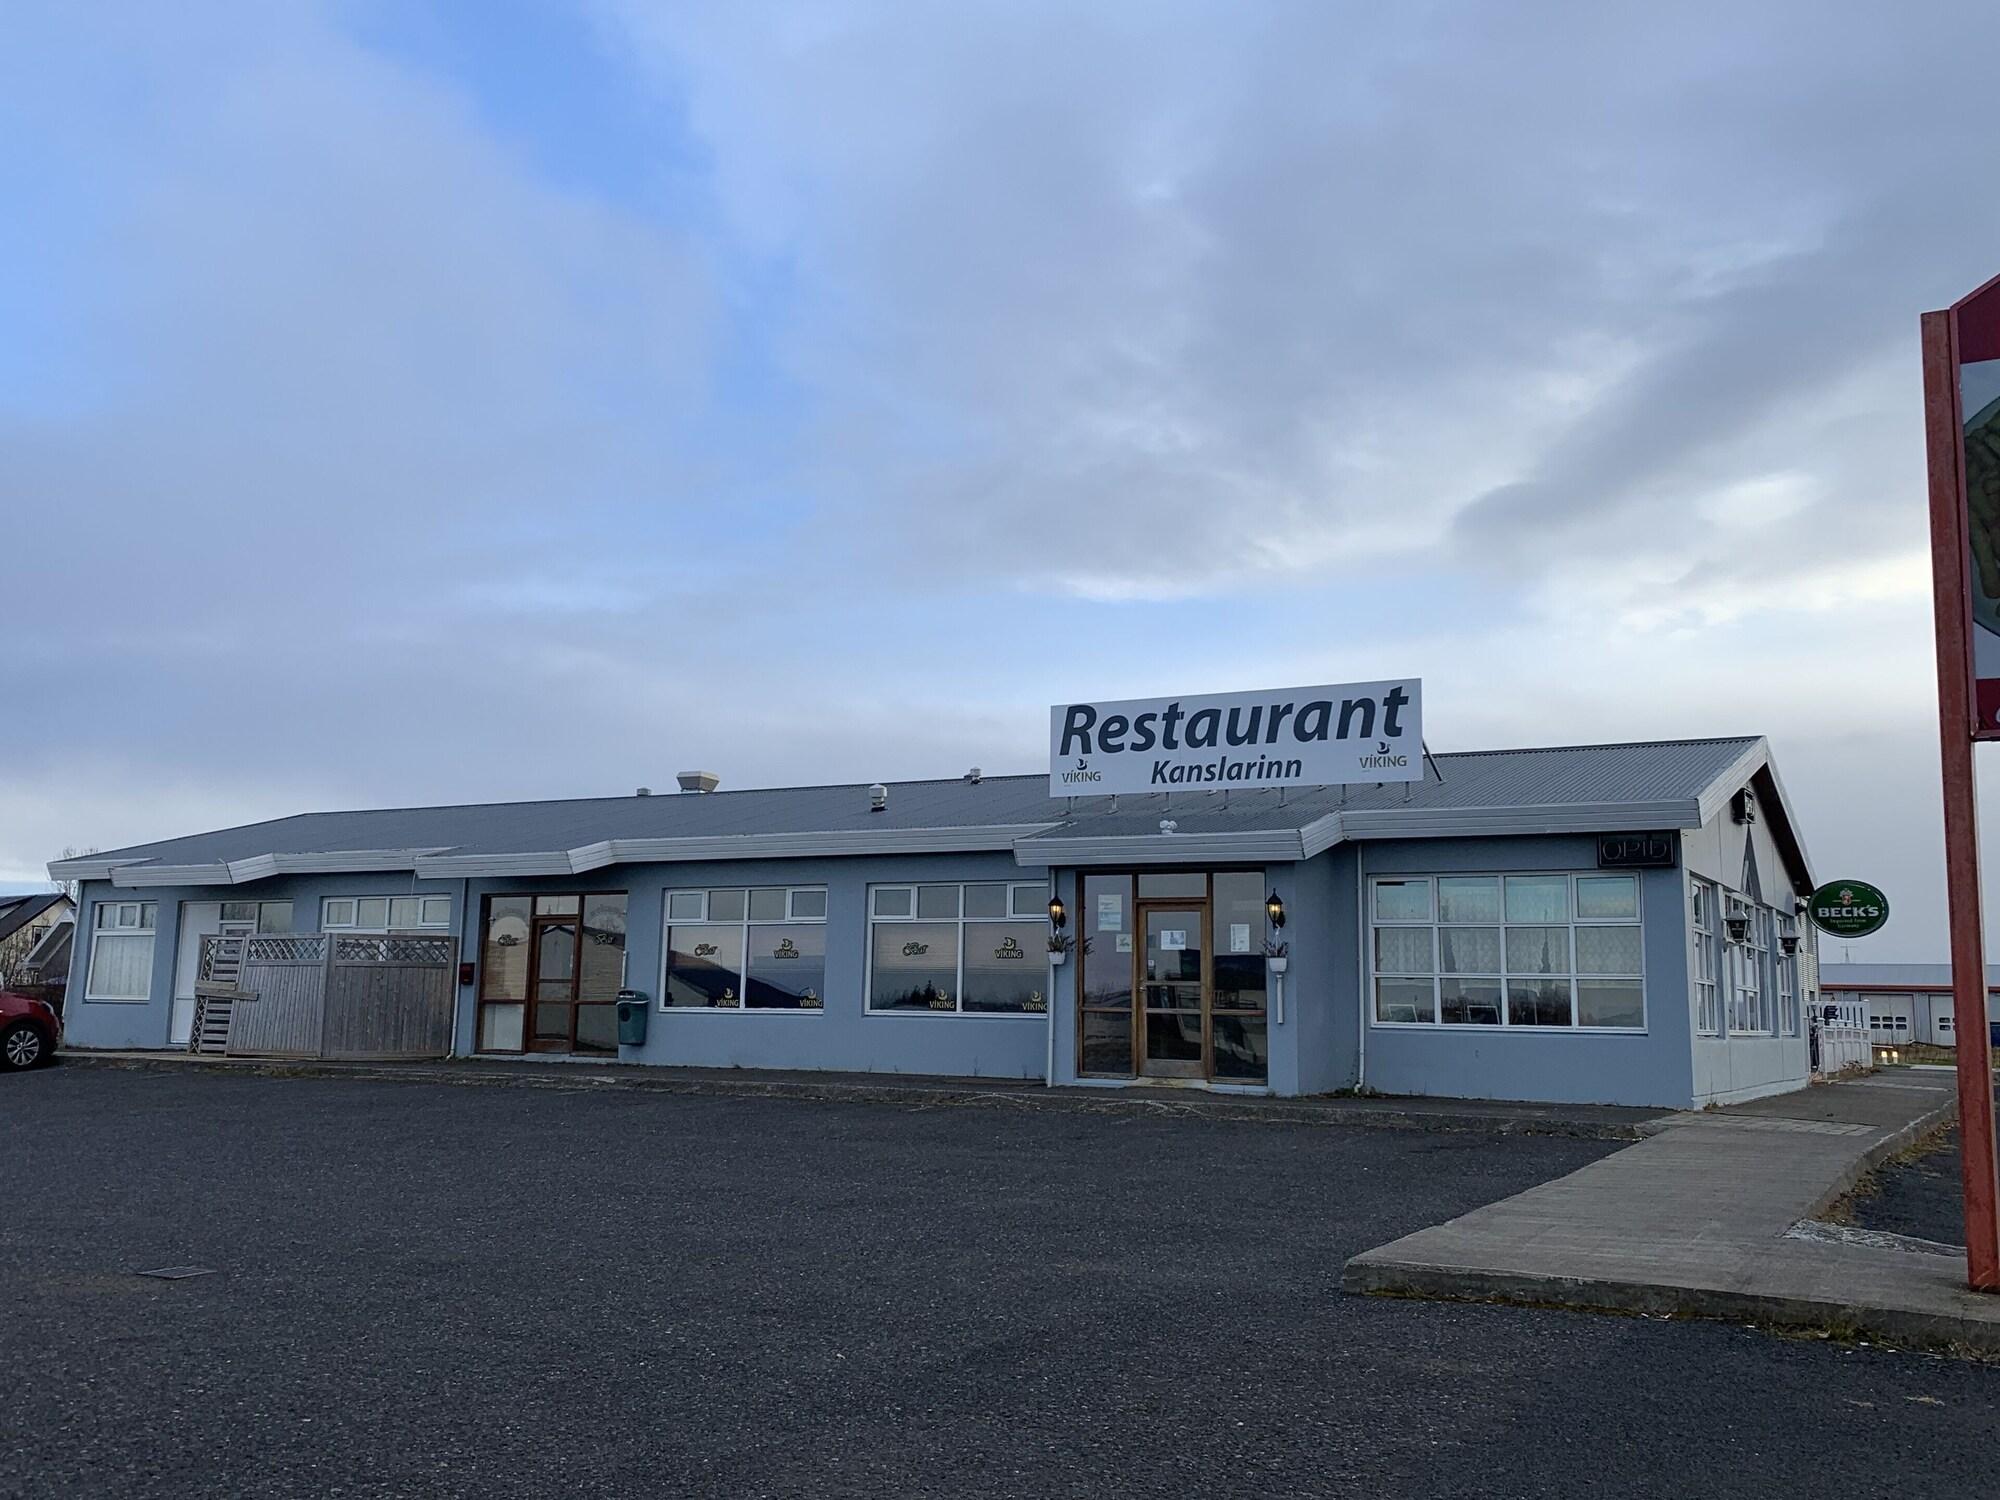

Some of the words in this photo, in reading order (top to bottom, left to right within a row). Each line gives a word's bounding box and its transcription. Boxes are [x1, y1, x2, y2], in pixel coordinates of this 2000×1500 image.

[1059, 685, 1409, 757] Restaurant
[1151, 753, 1303, 785] Kanslarinn
[1817, 904, 1880, 918] BECK'S
